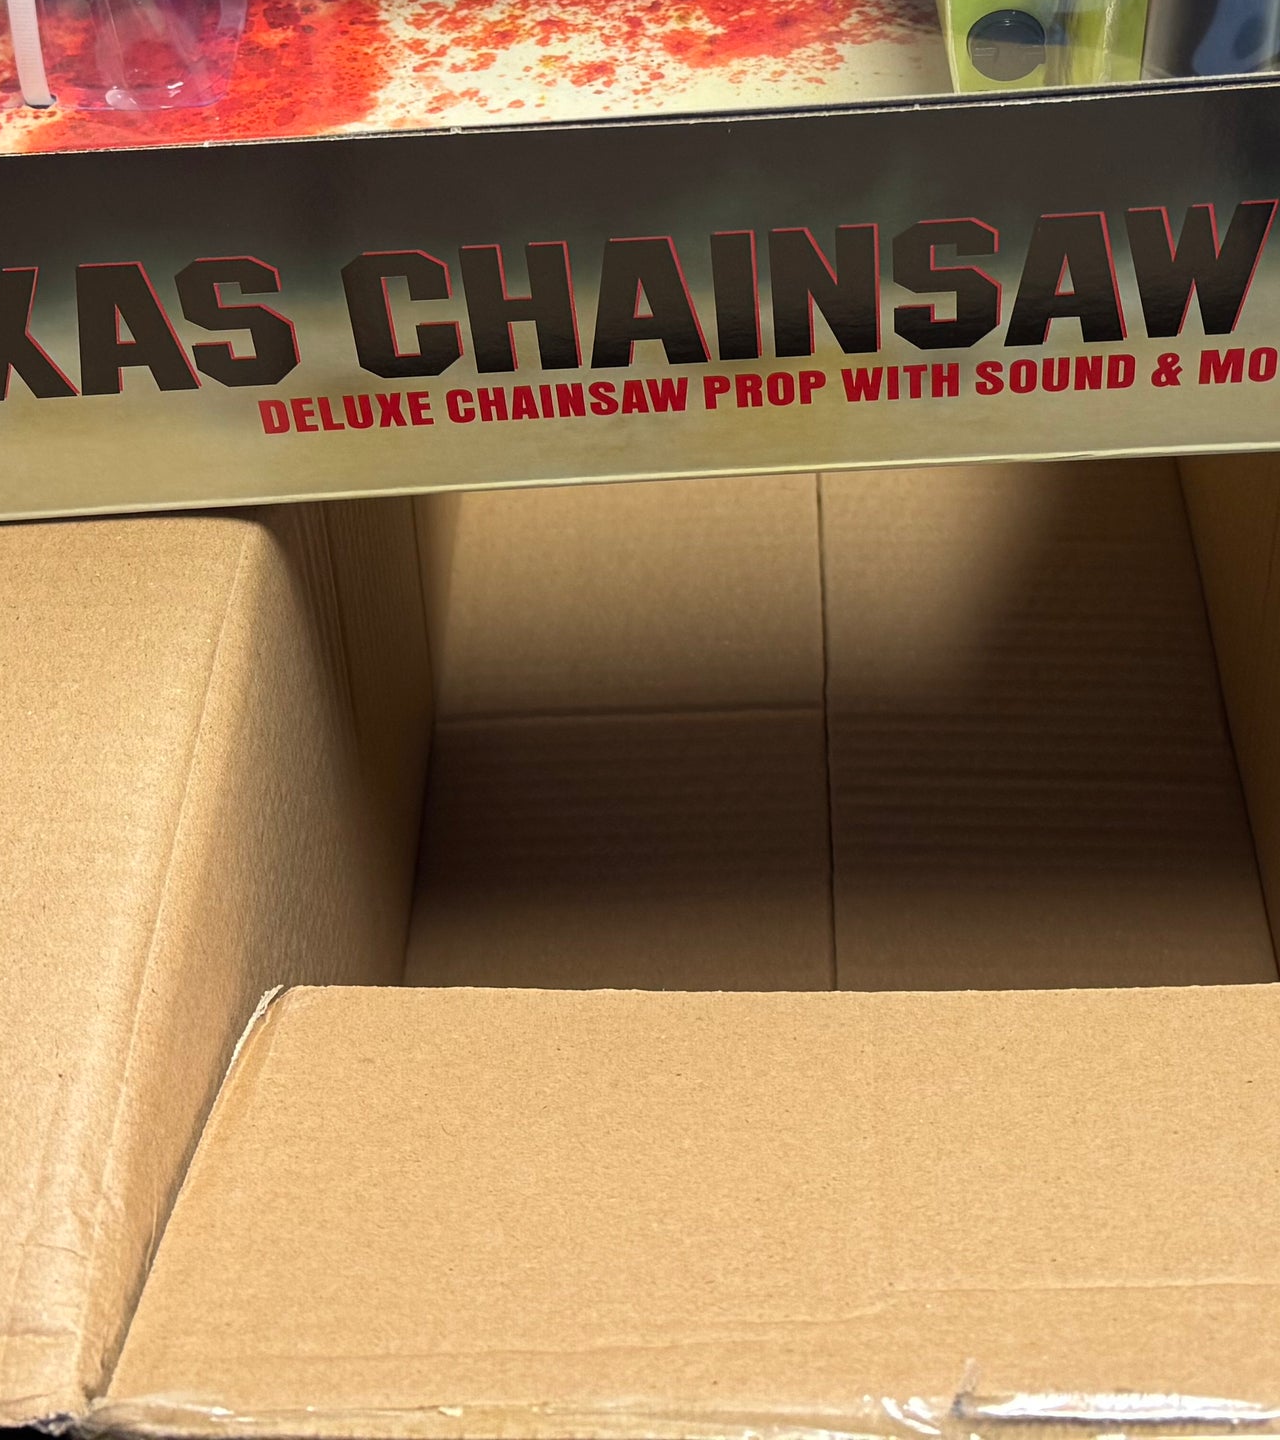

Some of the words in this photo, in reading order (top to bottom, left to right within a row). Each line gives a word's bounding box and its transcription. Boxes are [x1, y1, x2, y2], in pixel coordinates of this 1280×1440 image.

[342, 199, 1280, 379] CHAINSAW
[258, 390, 435, 435] DELUXE
[446, 378, 689, 424] CHAINSAW
[698, 369, 827, 411] PROP
[842, 362, 960, 403] WITH
[976, 354, 1137, 396] SOUND
[1152, 352, 1183, 388] &
